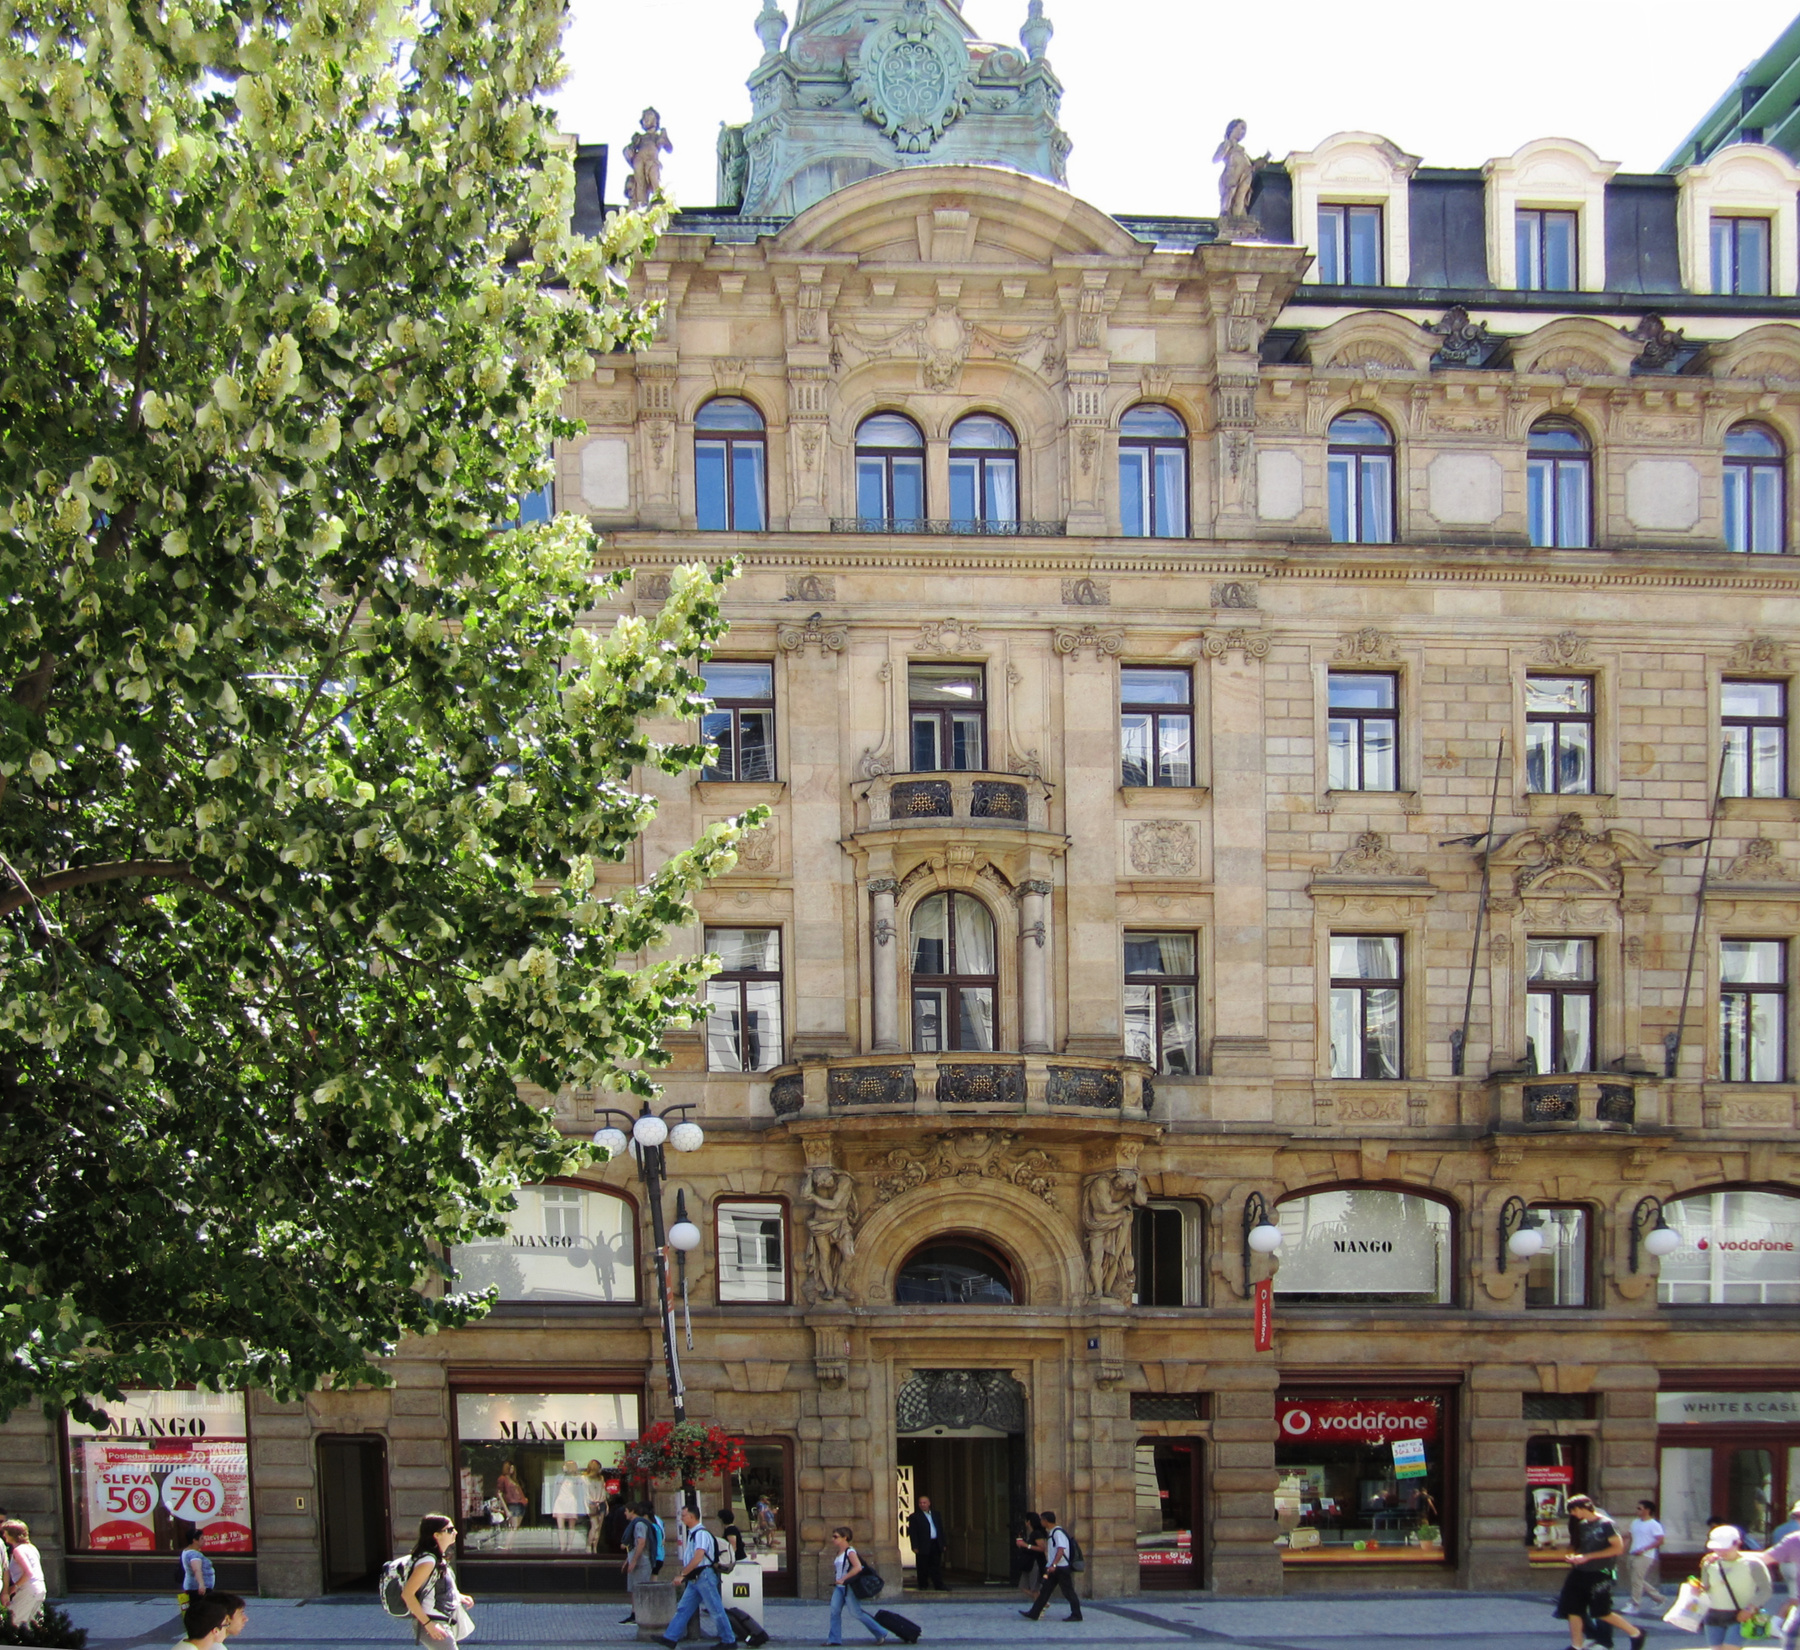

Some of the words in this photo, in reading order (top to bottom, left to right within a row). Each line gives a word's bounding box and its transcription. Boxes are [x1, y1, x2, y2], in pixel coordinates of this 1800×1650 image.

[512, 1234, 572, 1248] MANGO
[1333, 1240, 1392, 1253] MANGO
[1718, 1239, 1794, 1252] vodafone
[1683, 1402, 1739, 1413] WHITE
[1743, 1402, 1754, 1413] &
[1756, 1402, 1799, 1413] CASE
[108, 1417, 206, 1437] MANGO
[1318, 1411, 1429, 1430] vodafone
[499, 1420, 598, 1440] MANGO
[102, 1473, 154, 1485] SLEVA
[175, 1476, 211, 1486] NEBO
[896, 1467, 911, 1538] MANGO
